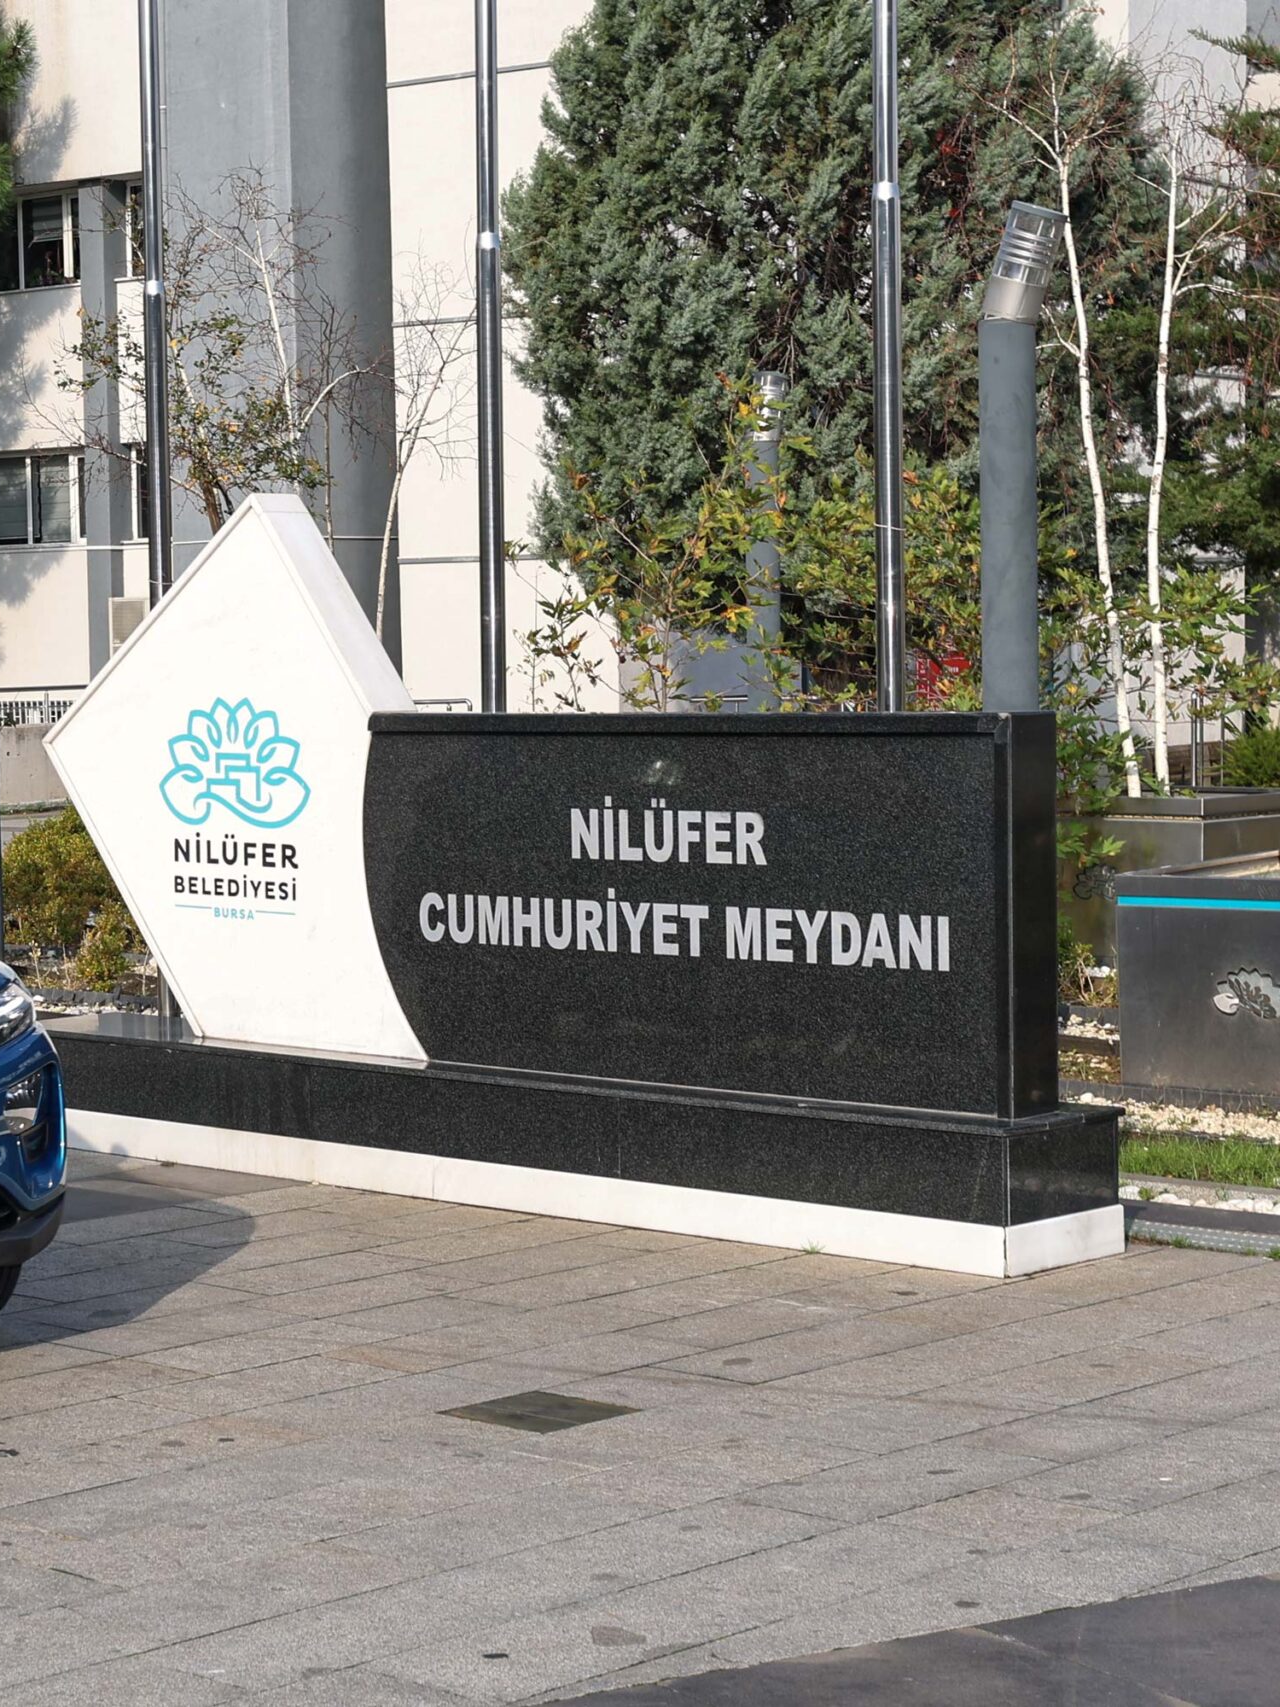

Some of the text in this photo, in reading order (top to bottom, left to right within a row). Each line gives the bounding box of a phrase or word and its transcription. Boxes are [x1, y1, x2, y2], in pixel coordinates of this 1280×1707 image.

[570, 796, 768, 866] NİLÜFER
[174, 832, 299, 870] NİLÜFER
[174, 874, 297, 902] BELEDİYESİ
[213, 906, 255, 921] BURSA
[418, 887, 951, 973] CUMHURİYET MEYDANI
